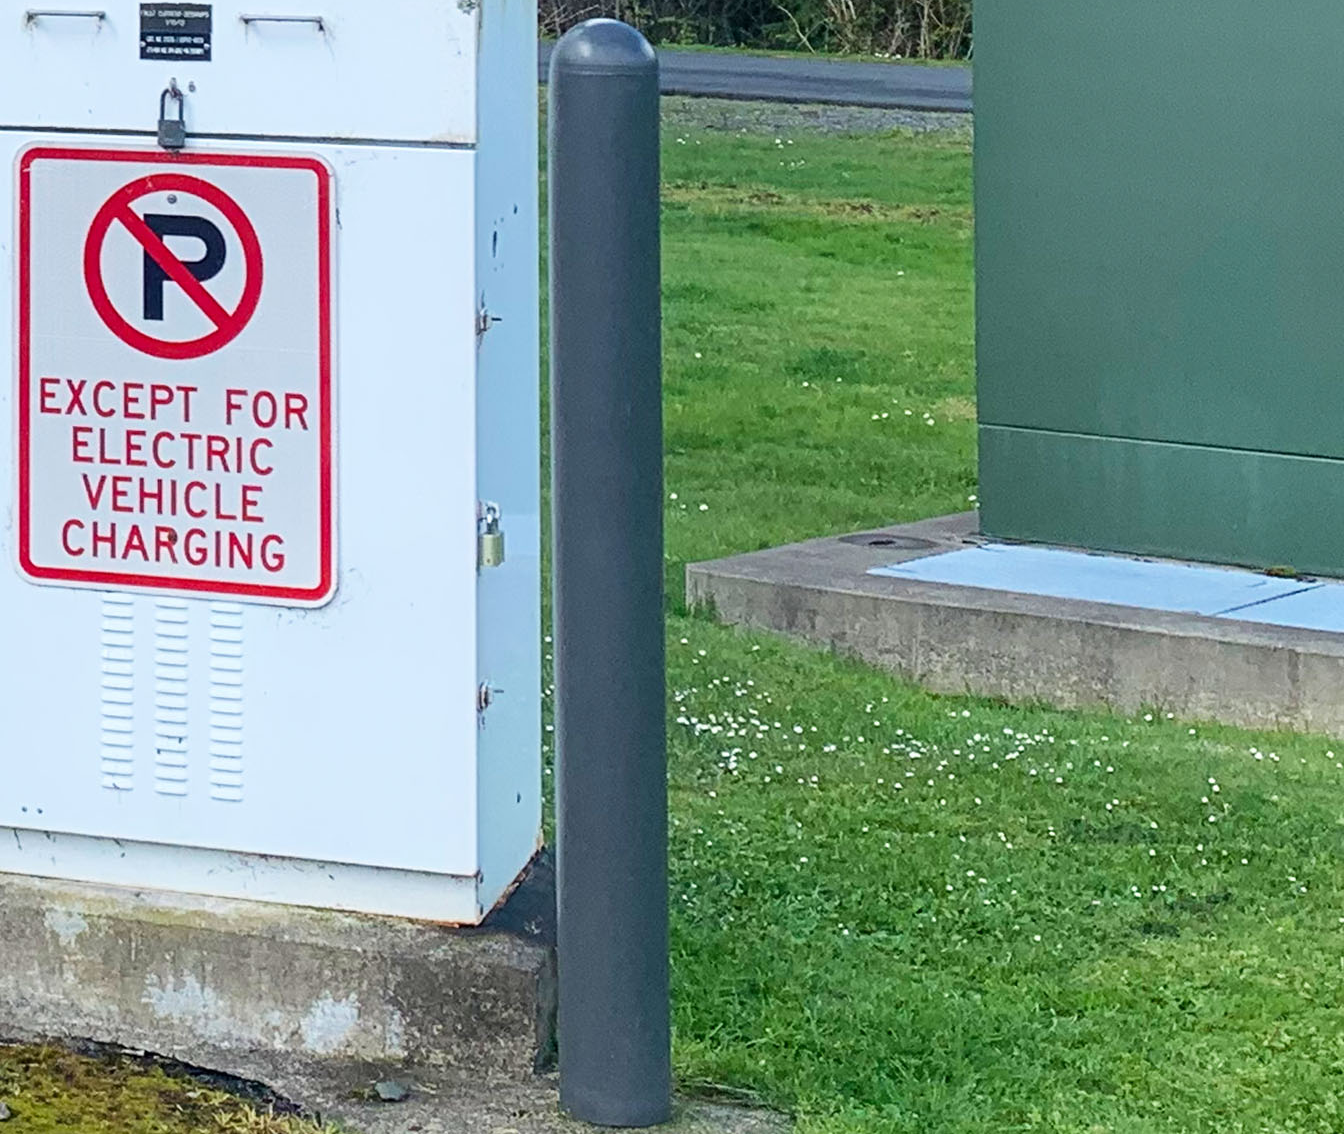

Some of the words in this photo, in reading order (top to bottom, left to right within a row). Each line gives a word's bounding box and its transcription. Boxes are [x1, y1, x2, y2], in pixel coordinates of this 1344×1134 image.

[39, 377, 198, 423] EXCEPT
[225, 388, 309, 431] FOR
[72, 426, 274, 476] ELECTRIC
[82, 473, 264, 523] VEHICLE
[62, 519, 285, 573] CHARGING
